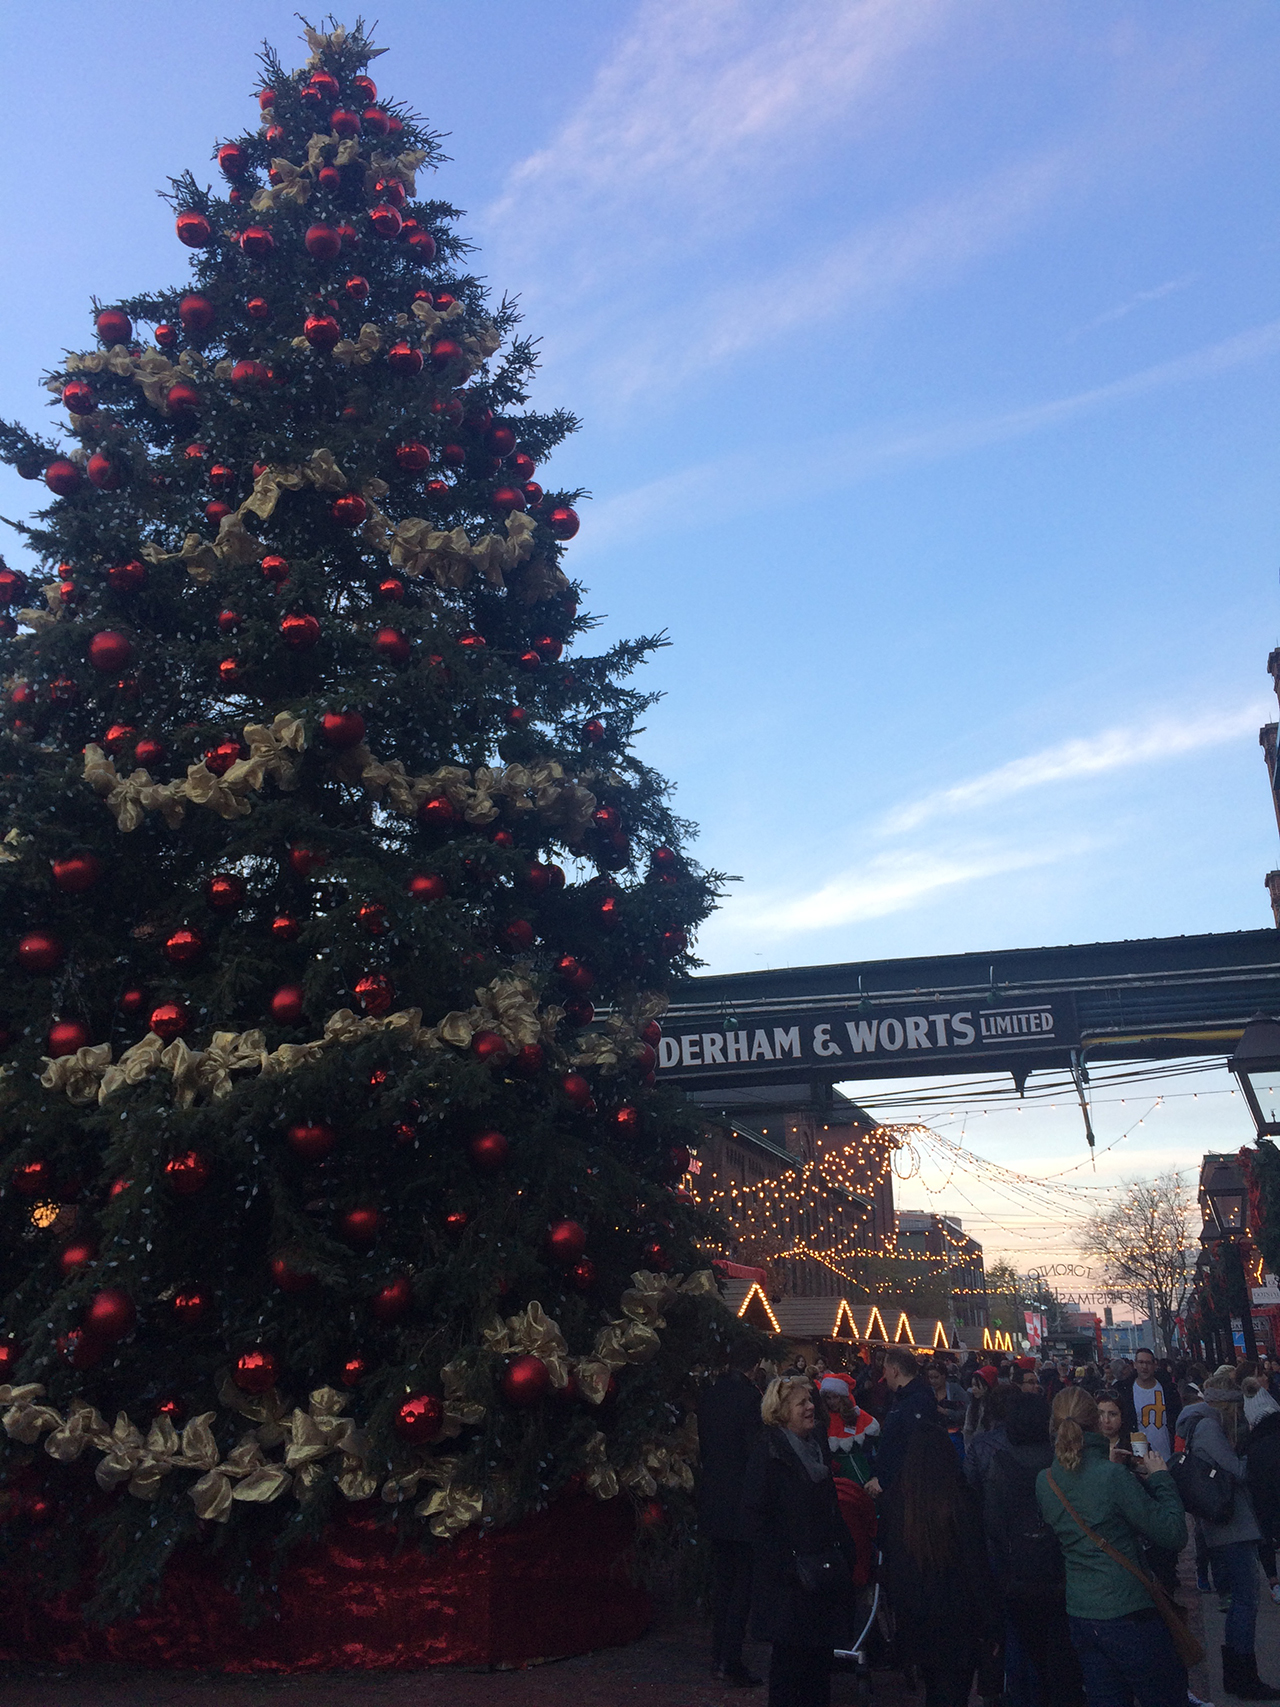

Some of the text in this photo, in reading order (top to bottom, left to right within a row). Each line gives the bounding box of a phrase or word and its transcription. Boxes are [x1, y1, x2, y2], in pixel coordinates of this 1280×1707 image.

[812, 1023, 843, 1057] &
[845, 1011, 976, 1053] WORTS
[980, 1012, 1054, 1036] LIMITED
